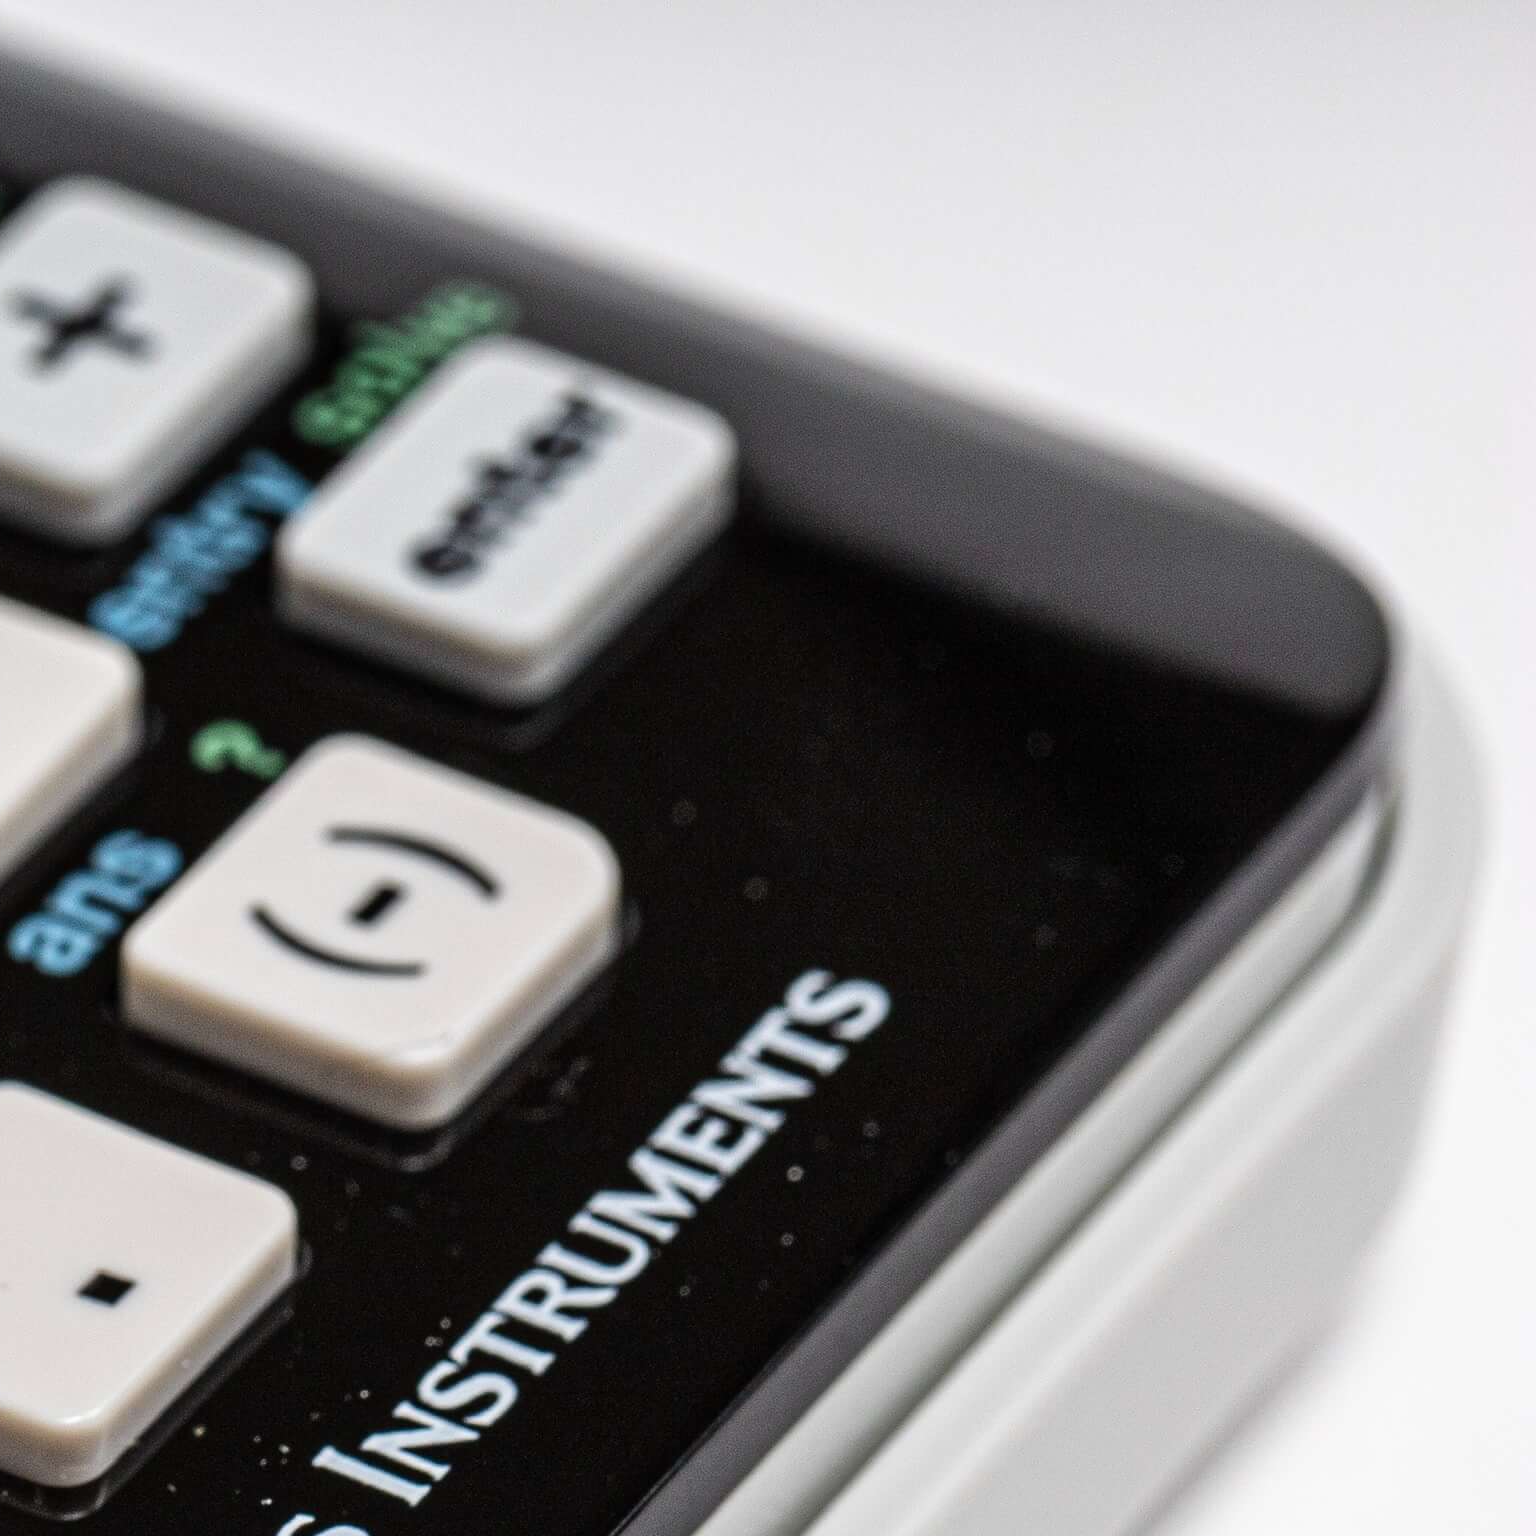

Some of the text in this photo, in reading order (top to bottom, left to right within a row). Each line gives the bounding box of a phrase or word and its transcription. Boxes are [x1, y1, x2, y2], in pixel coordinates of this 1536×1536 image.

[22, 287, 142, 367] +
[90, 456, 314, 649] entry
[408, 388, 628, 584] enter
[192, 722, 285, 778] ?
[10, 831, 182, 974] ans
[313, 970, 891, 1507] INSTRUMENTS
